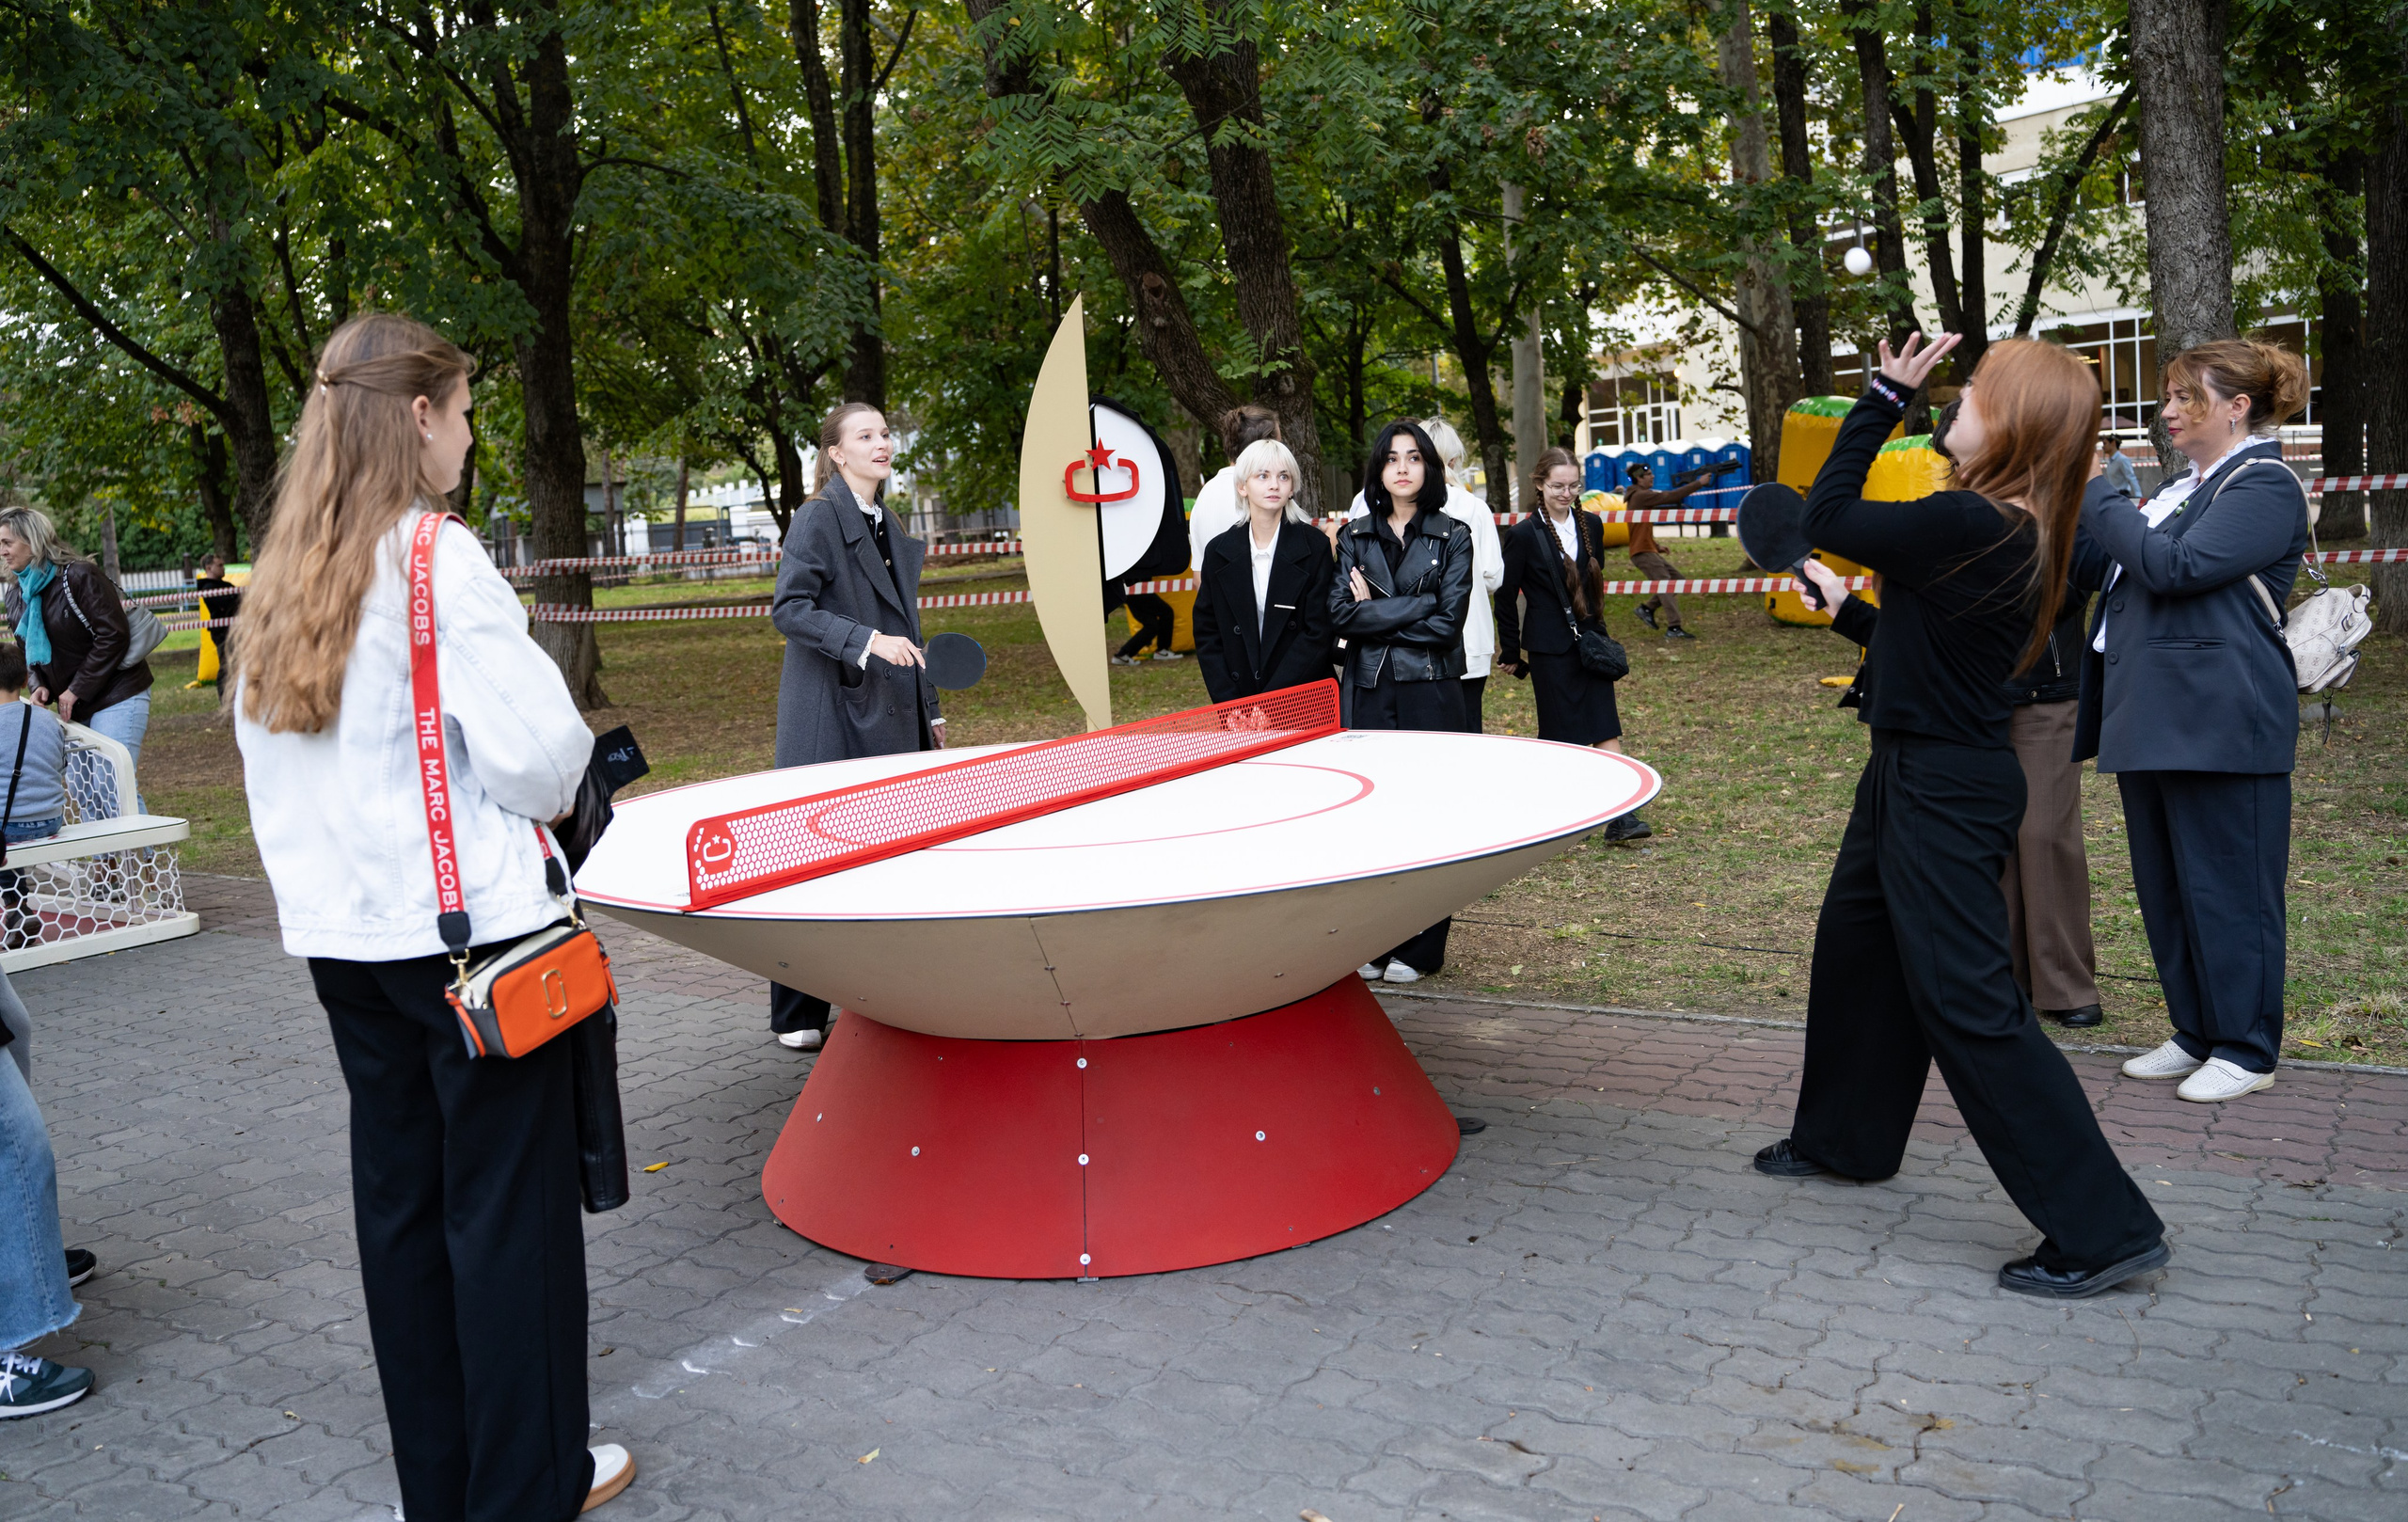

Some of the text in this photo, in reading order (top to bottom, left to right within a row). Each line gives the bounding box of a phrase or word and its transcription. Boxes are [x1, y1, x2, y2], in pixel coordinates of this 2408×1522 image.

[414, 554, 431, 646] JACOBS
[420, 707, 438, 750] THE
[424, 759, 447, 821] MARC
